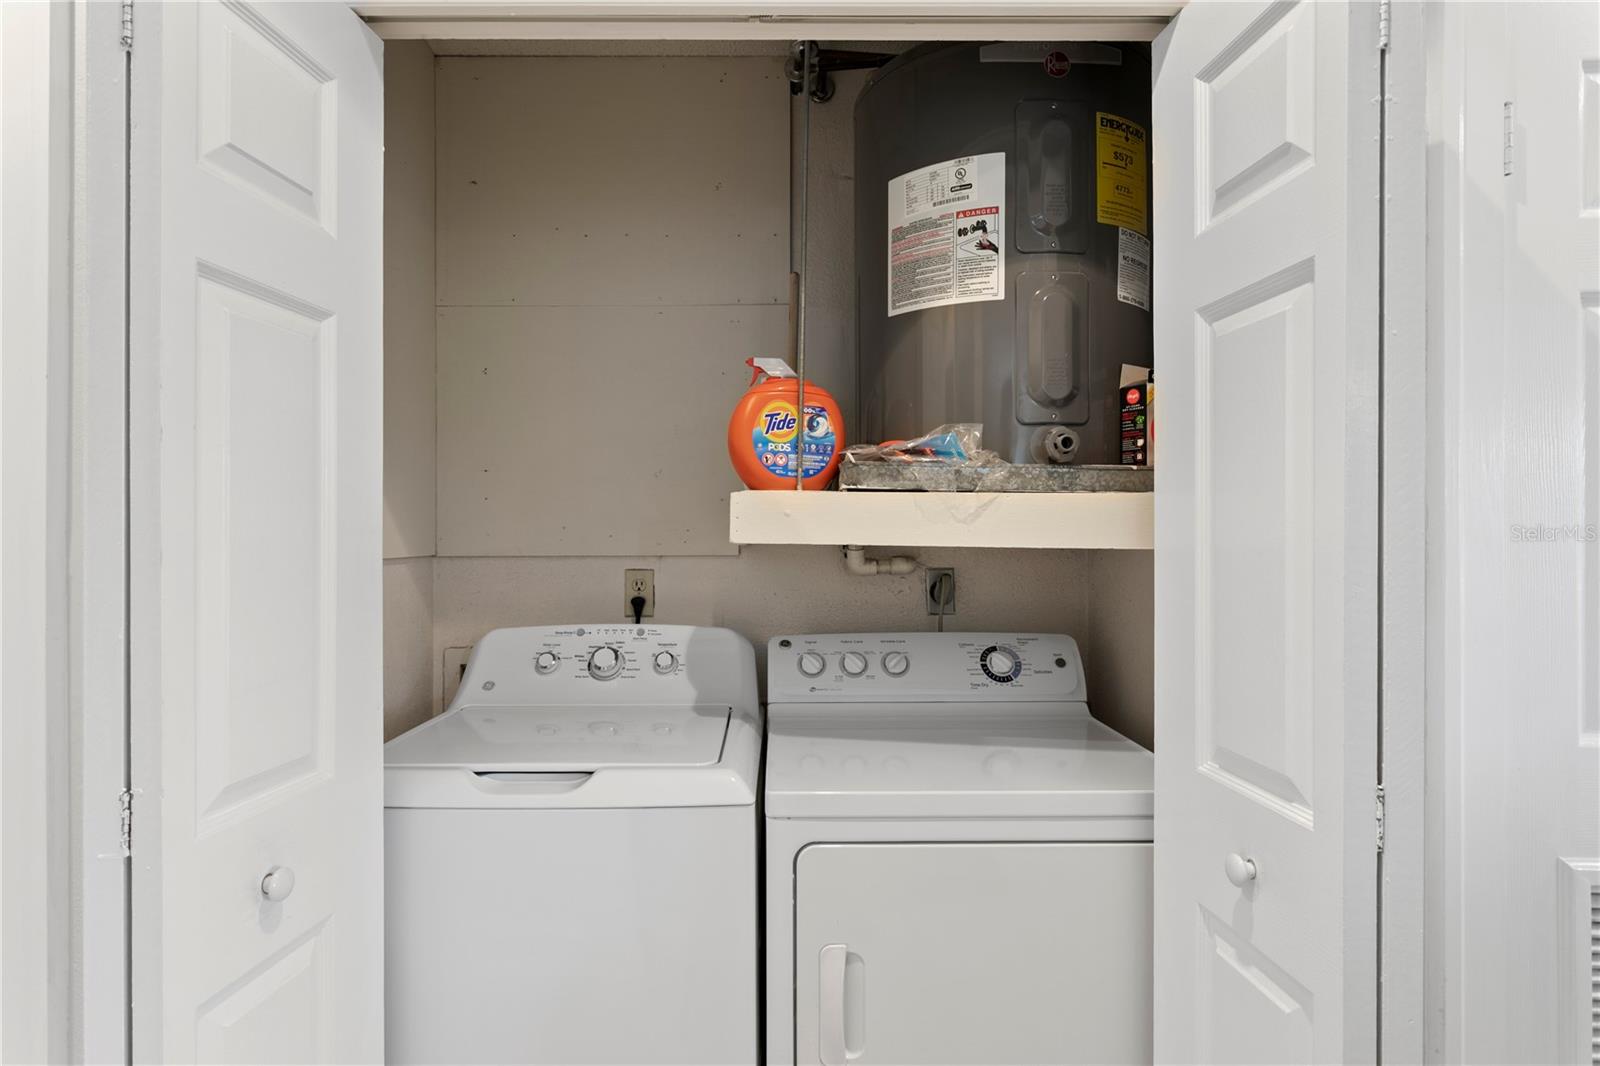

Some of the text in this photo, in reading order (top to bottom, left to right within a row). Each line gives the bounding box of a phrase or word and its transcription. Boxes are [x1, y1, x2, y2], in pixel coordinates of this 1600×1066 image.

[965, 207, 997, 217] DANGER
[764, 411, 797, 435] Tide
[768, 442, 792, 452] PODS
